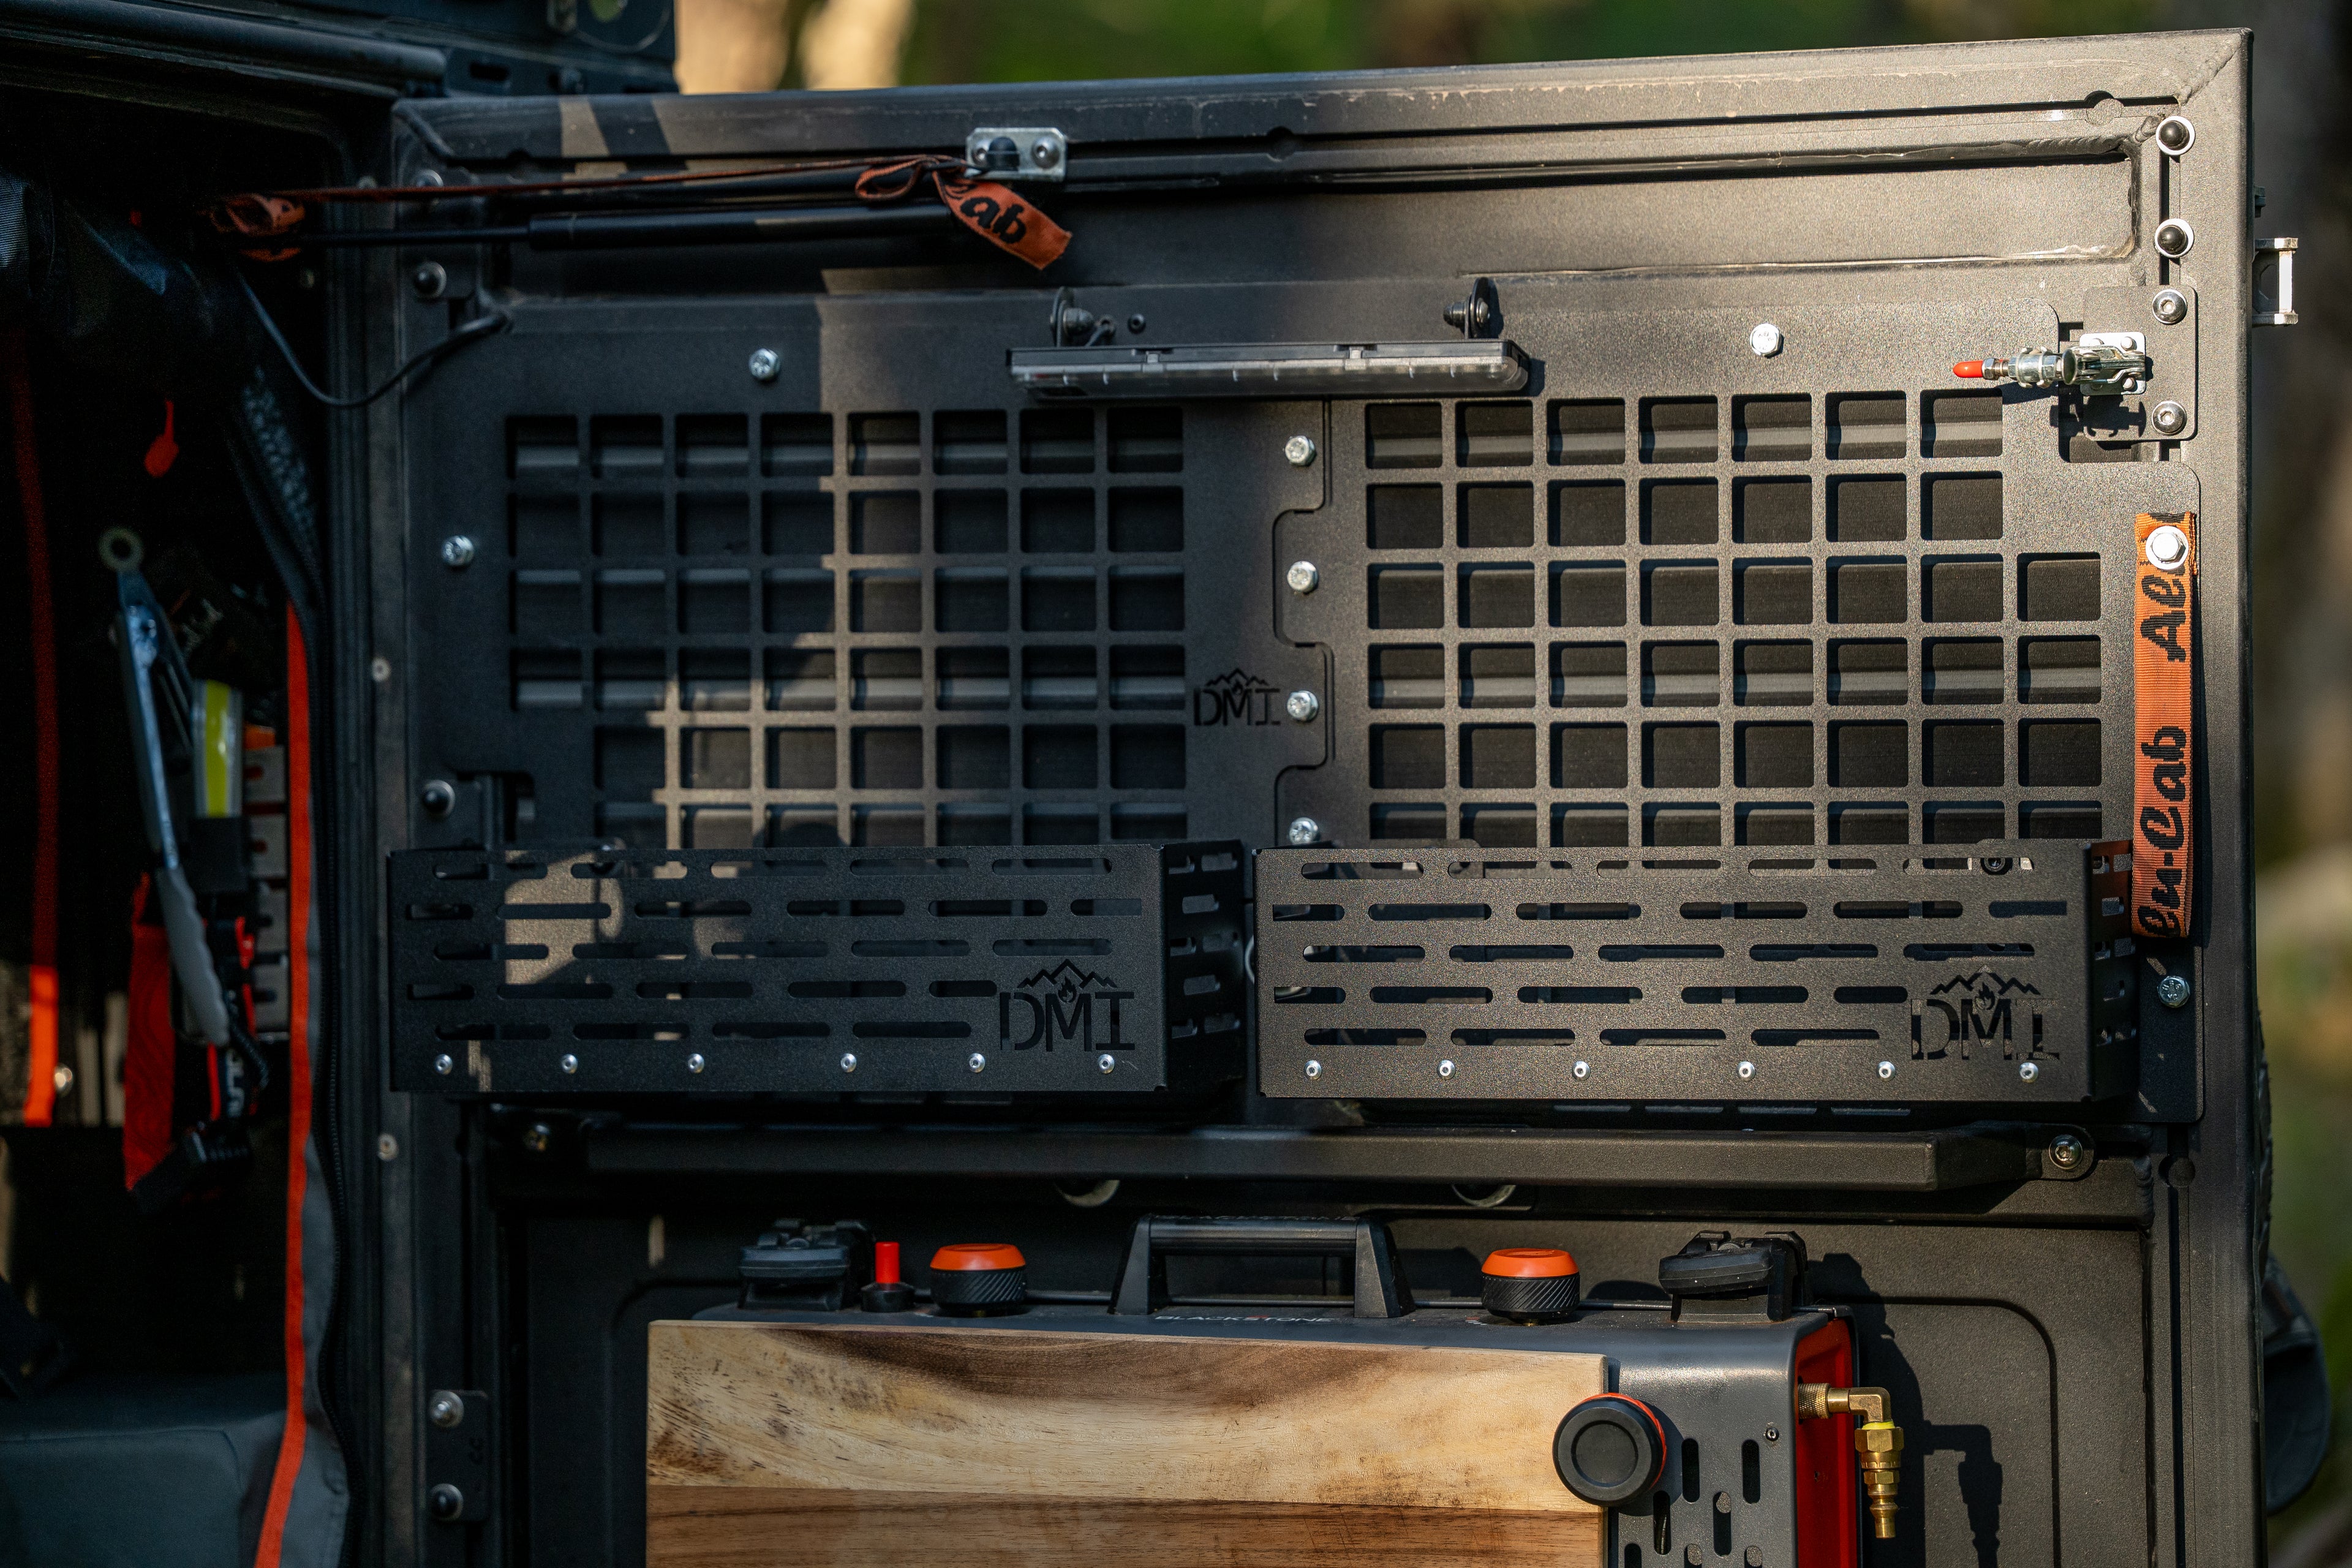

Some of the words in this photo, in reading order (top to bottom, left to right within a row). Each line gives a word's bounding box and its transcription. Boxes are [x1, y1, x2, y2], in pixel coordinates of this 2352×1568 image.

[1193, 687, 1281, 726] DMI
[999, 991, 1136, 1052] DMI
[1910, 998, 2060, 1060] DMI
